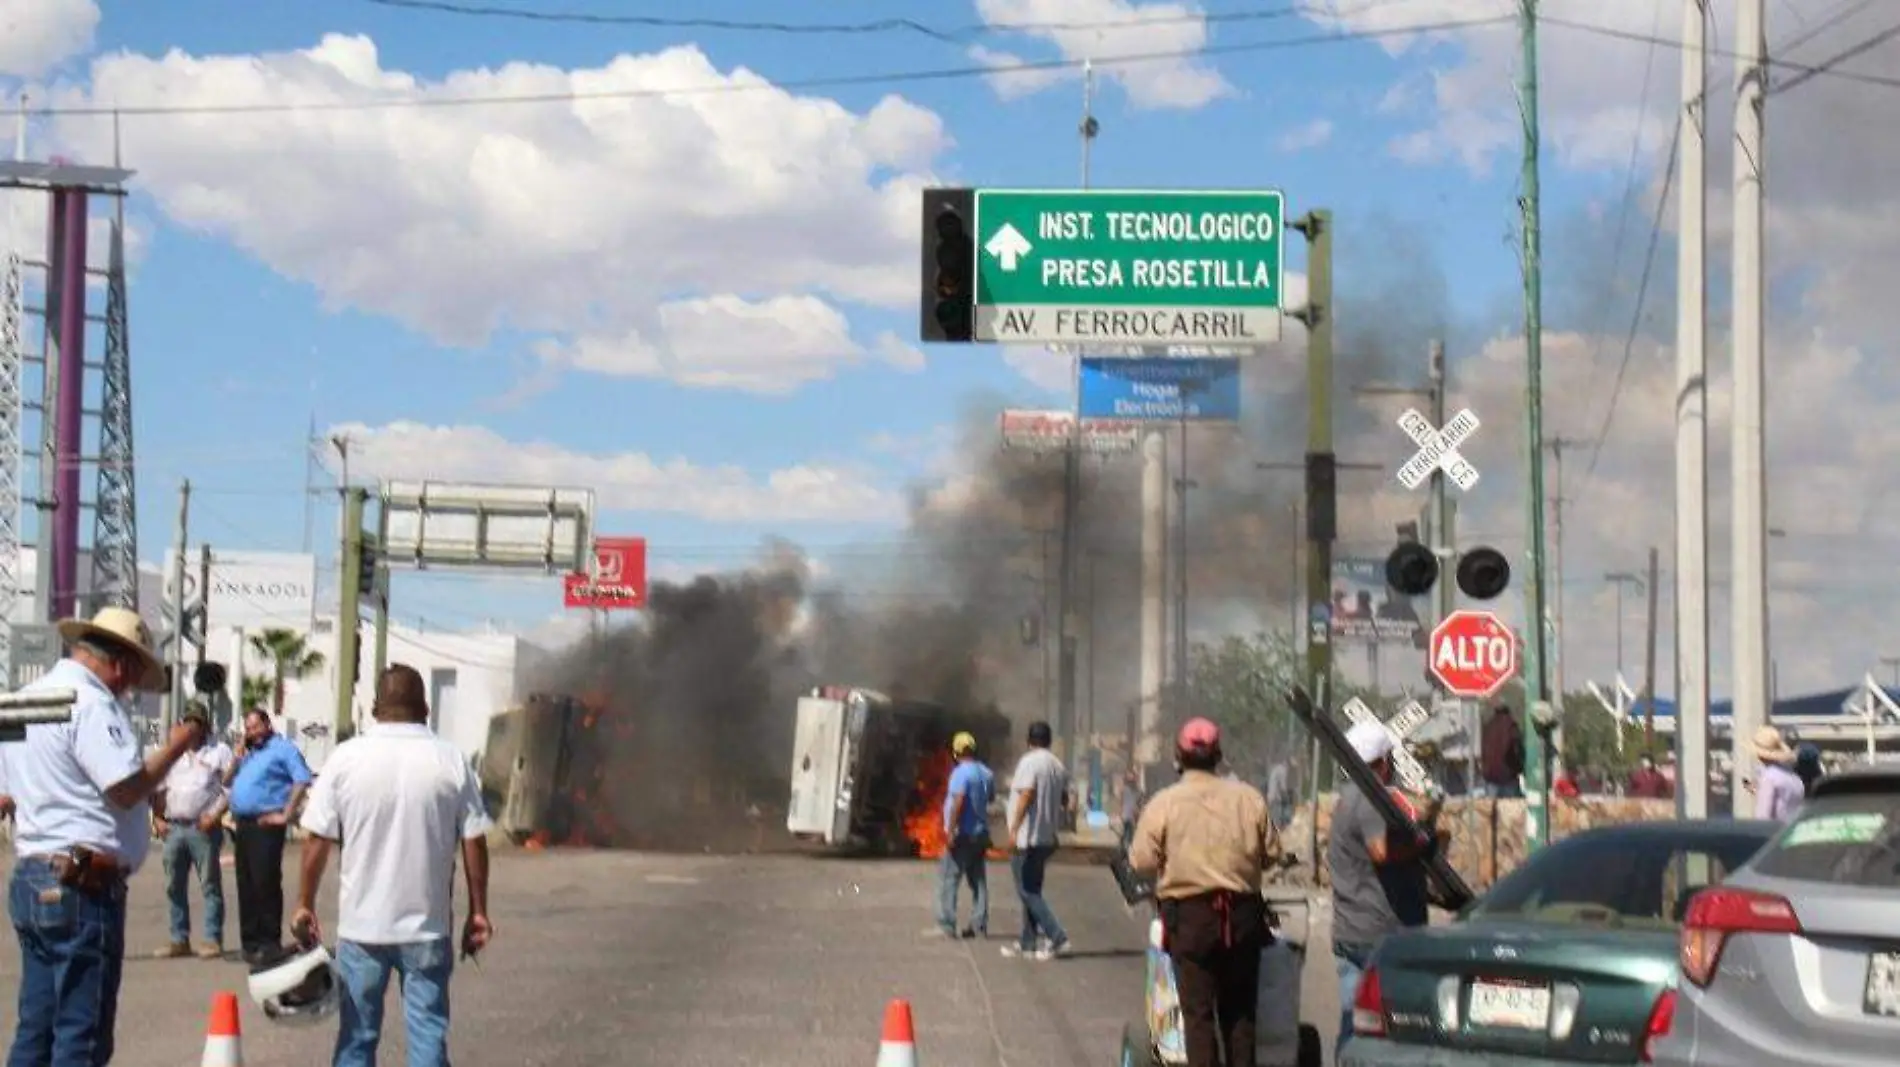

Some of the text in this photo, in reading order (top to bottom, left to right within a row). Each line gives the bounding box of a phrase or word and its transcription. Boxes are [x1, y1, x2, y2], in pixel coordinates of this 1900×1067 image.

[1039, 211, 1273, 241] INST. TECNOLOGICO
[1042, 259, 1270, 288] PRESA ROSETILLA
[1001, 310, 1256, 338] AV. FERROCARRIL
[1436, 635, 1509, 671] ALTO
